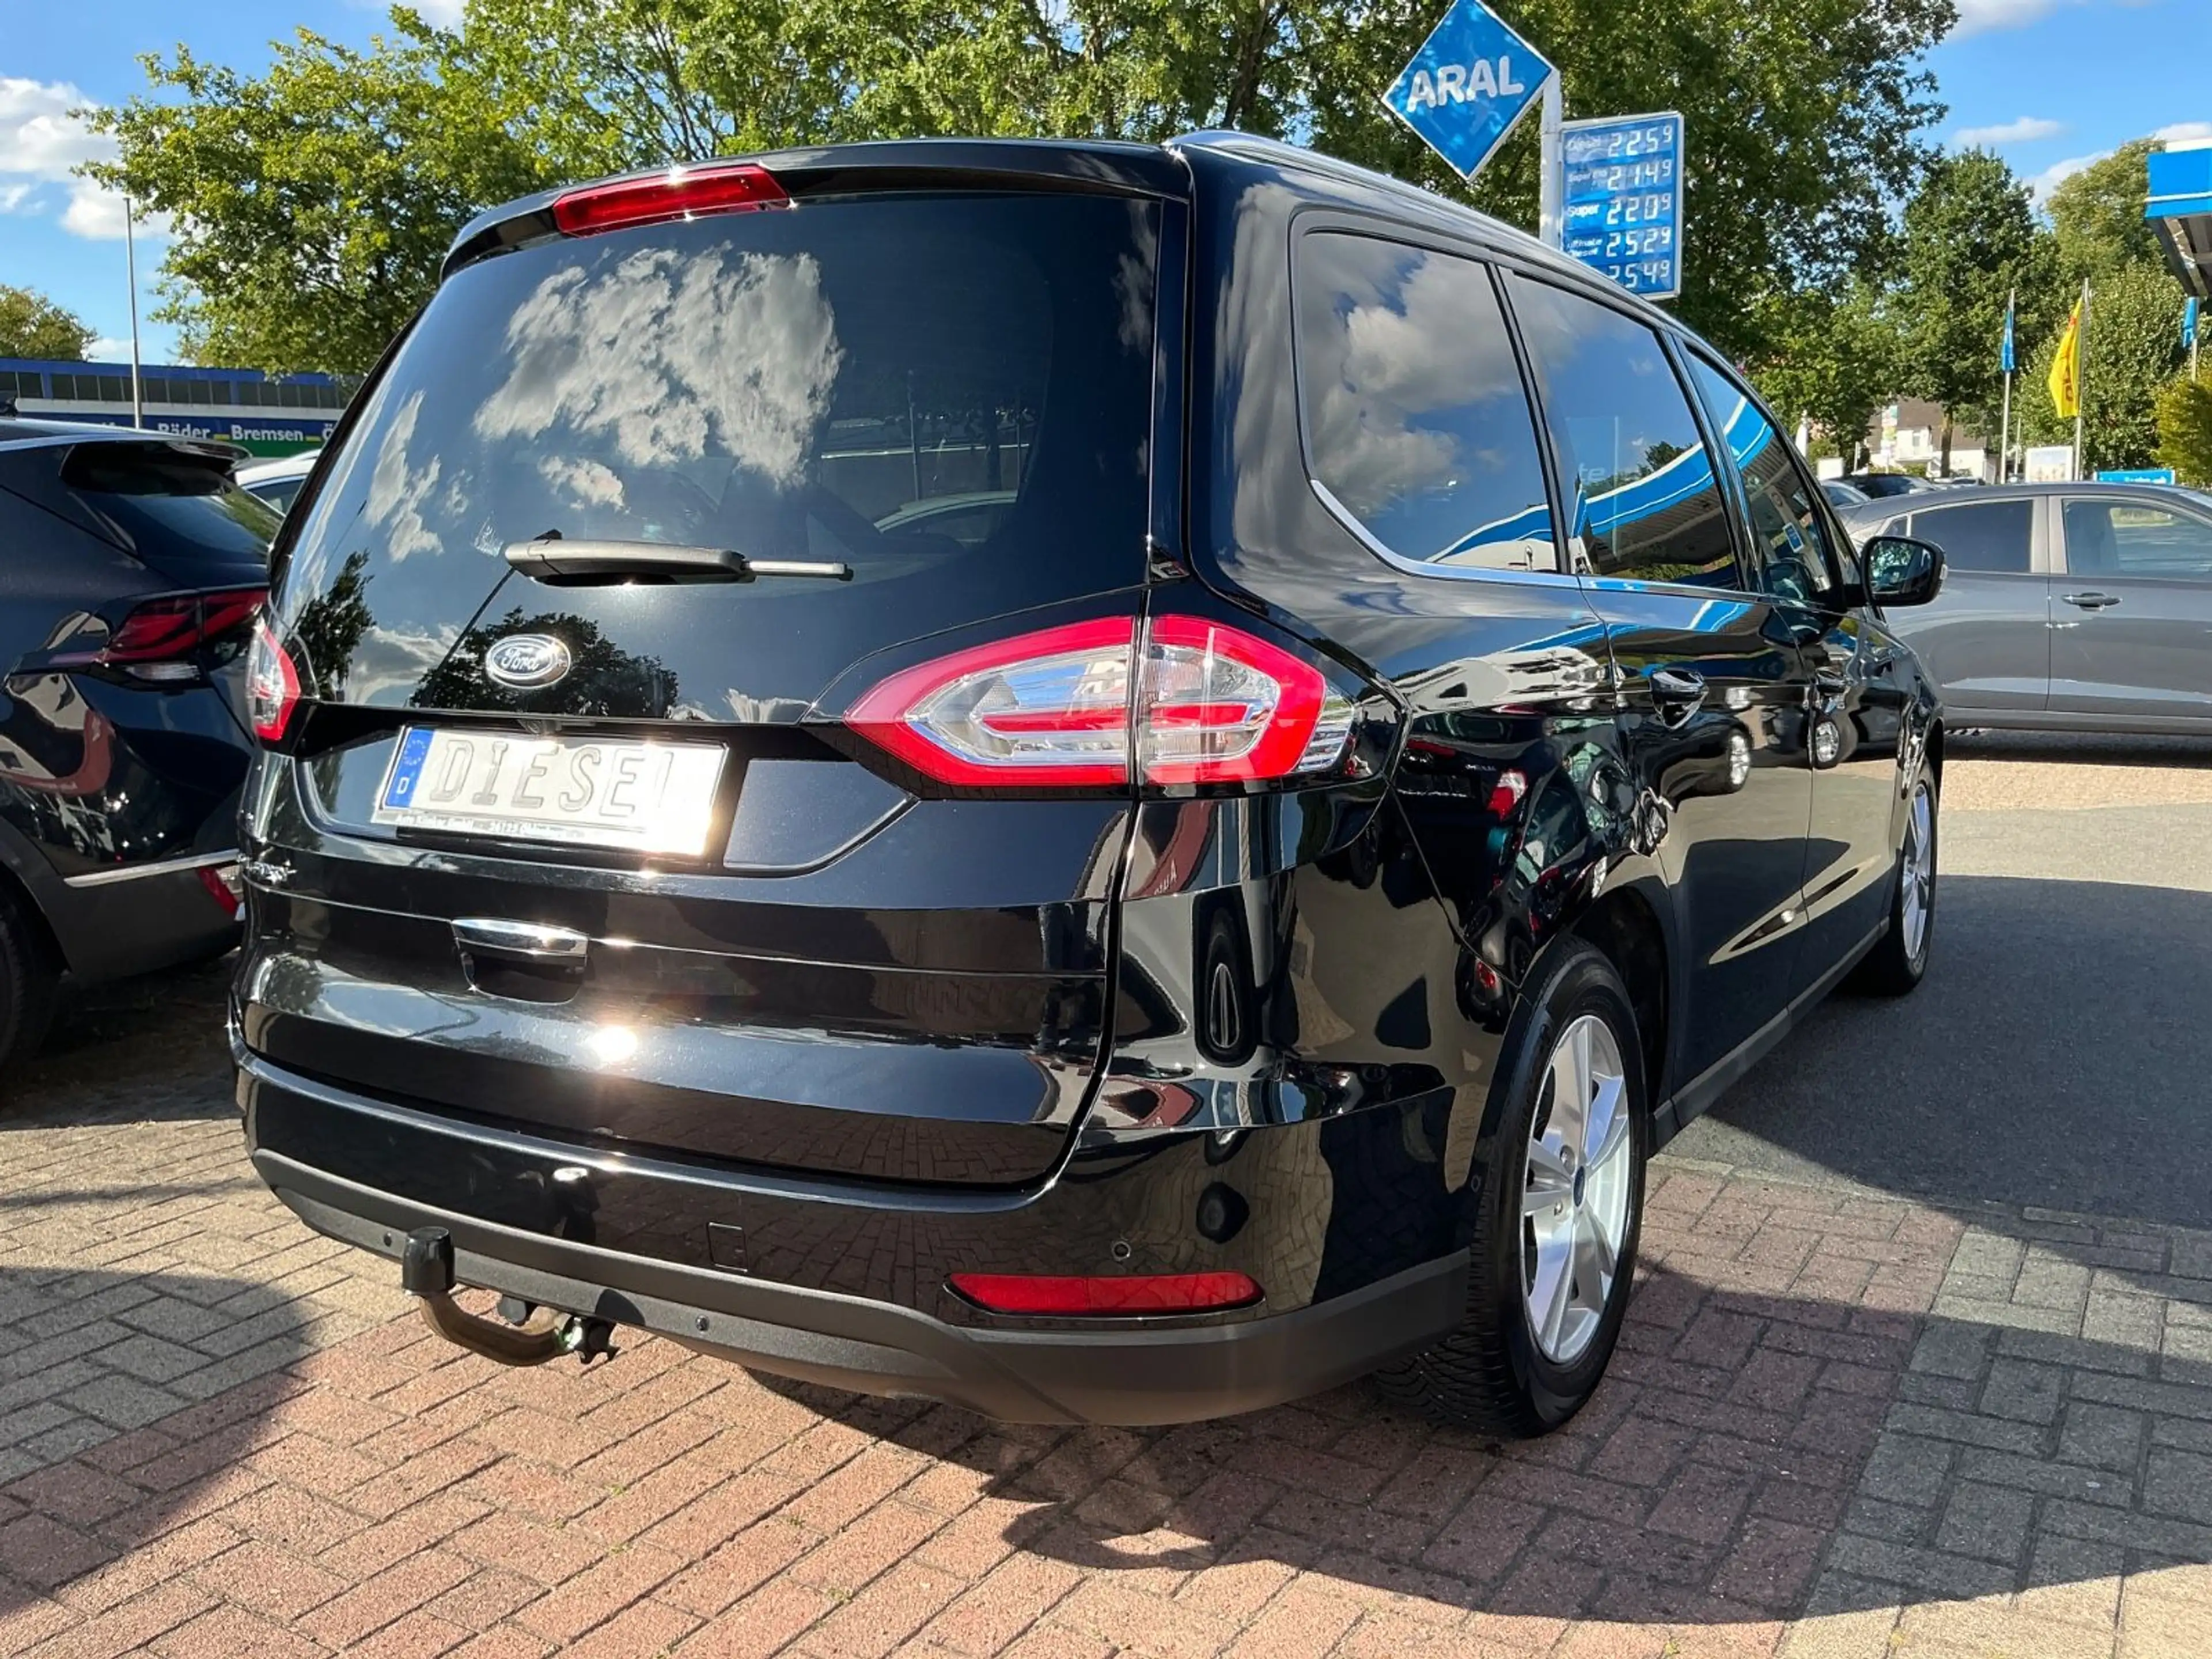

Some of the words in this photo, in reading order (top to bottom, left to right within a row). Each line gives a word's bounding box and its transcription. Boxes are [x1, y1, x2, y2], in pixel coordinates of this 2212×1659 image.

[1406, 56, 1525, 113] ARAL
[1568, 204, 1600, 217] Super
[231, 425, 304, 441] Bremsen
[501, 647, 540, 671] Ford
[397, 777, 410, 794] D
